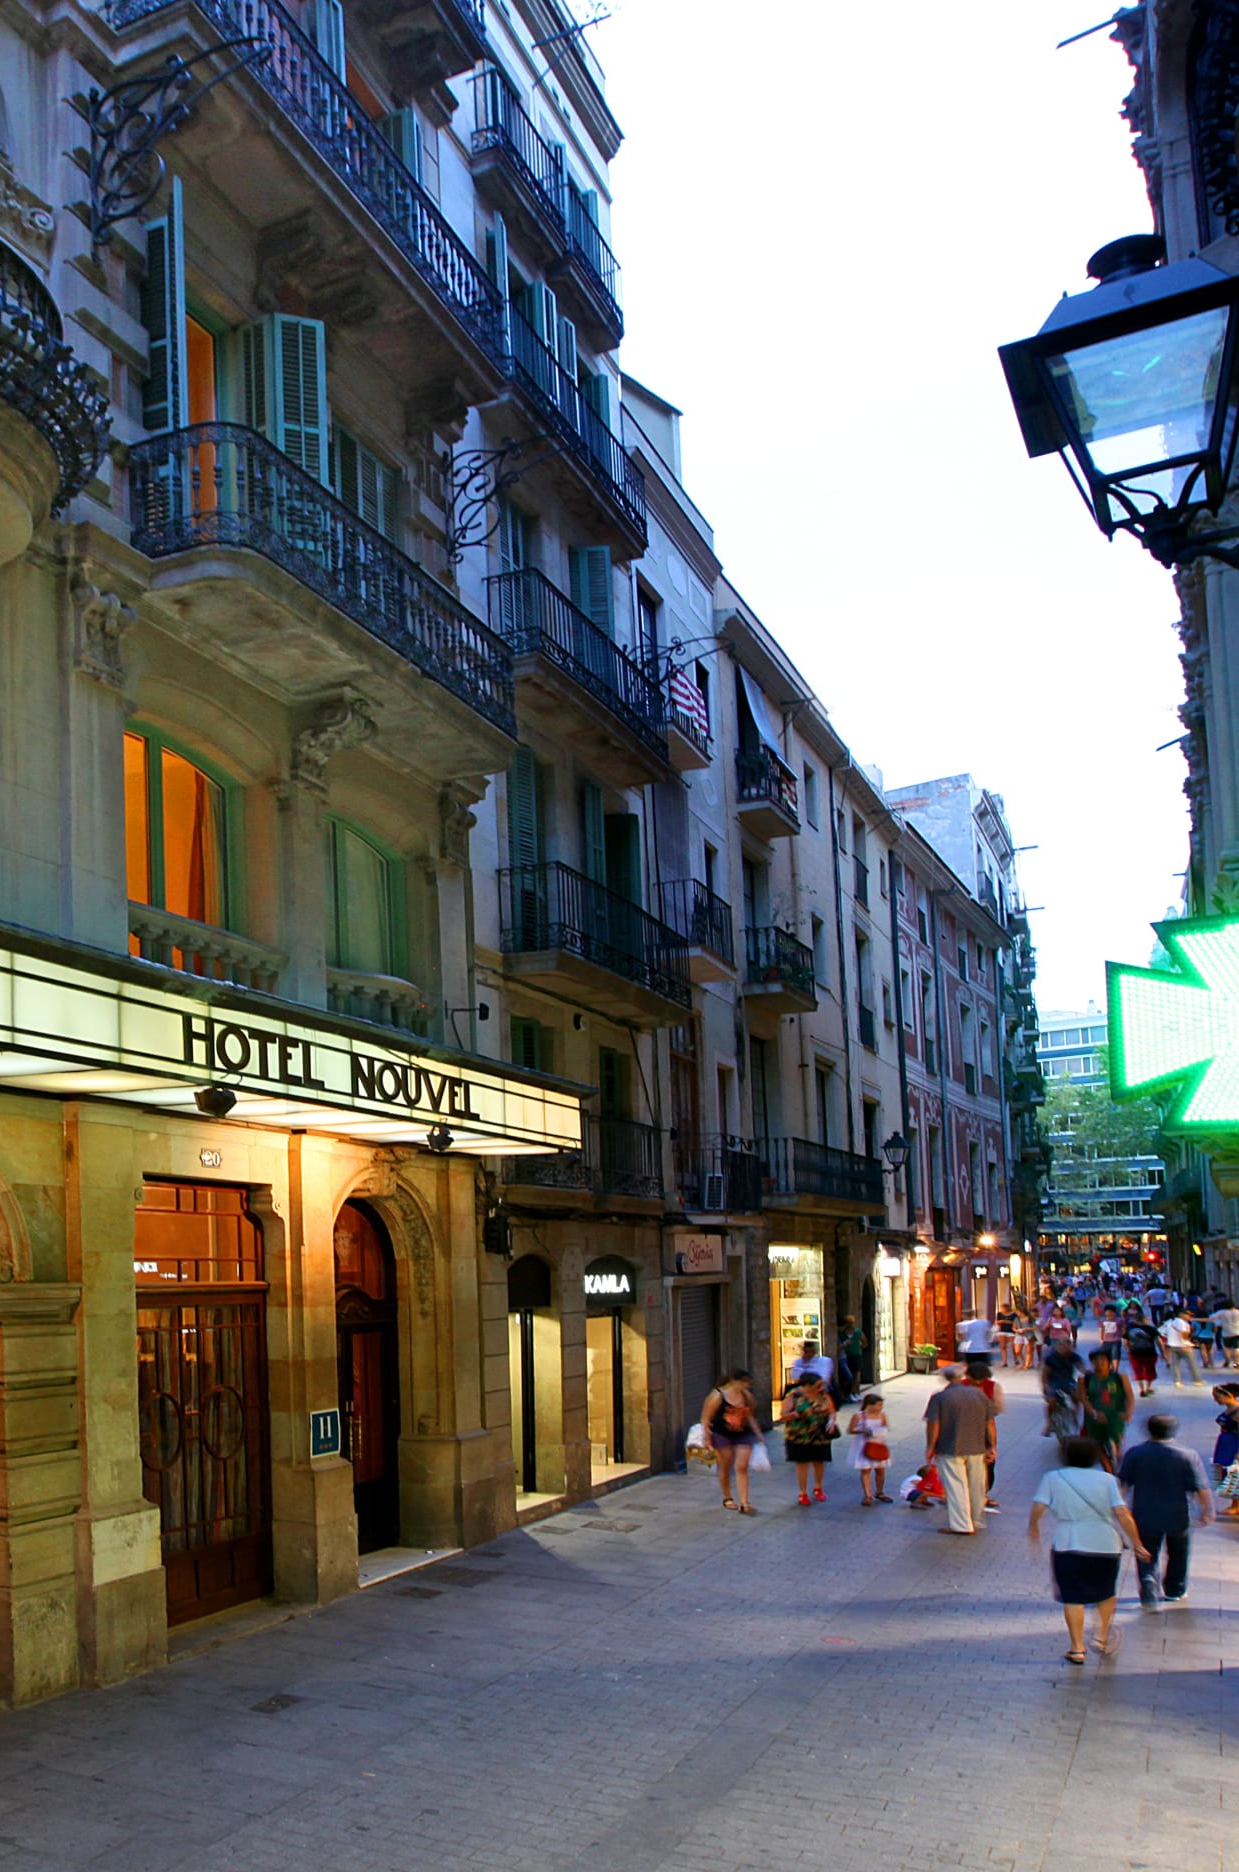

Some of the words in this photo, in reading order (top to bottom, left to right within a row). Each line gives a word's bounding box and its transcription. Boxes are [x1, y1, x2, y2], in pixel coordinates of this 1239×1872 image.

[182, 1012, 325, 1090] HOTEL
[351, 1054, 480, 1121] NOUVEL
[201, 1150, 221, 1167] 20
